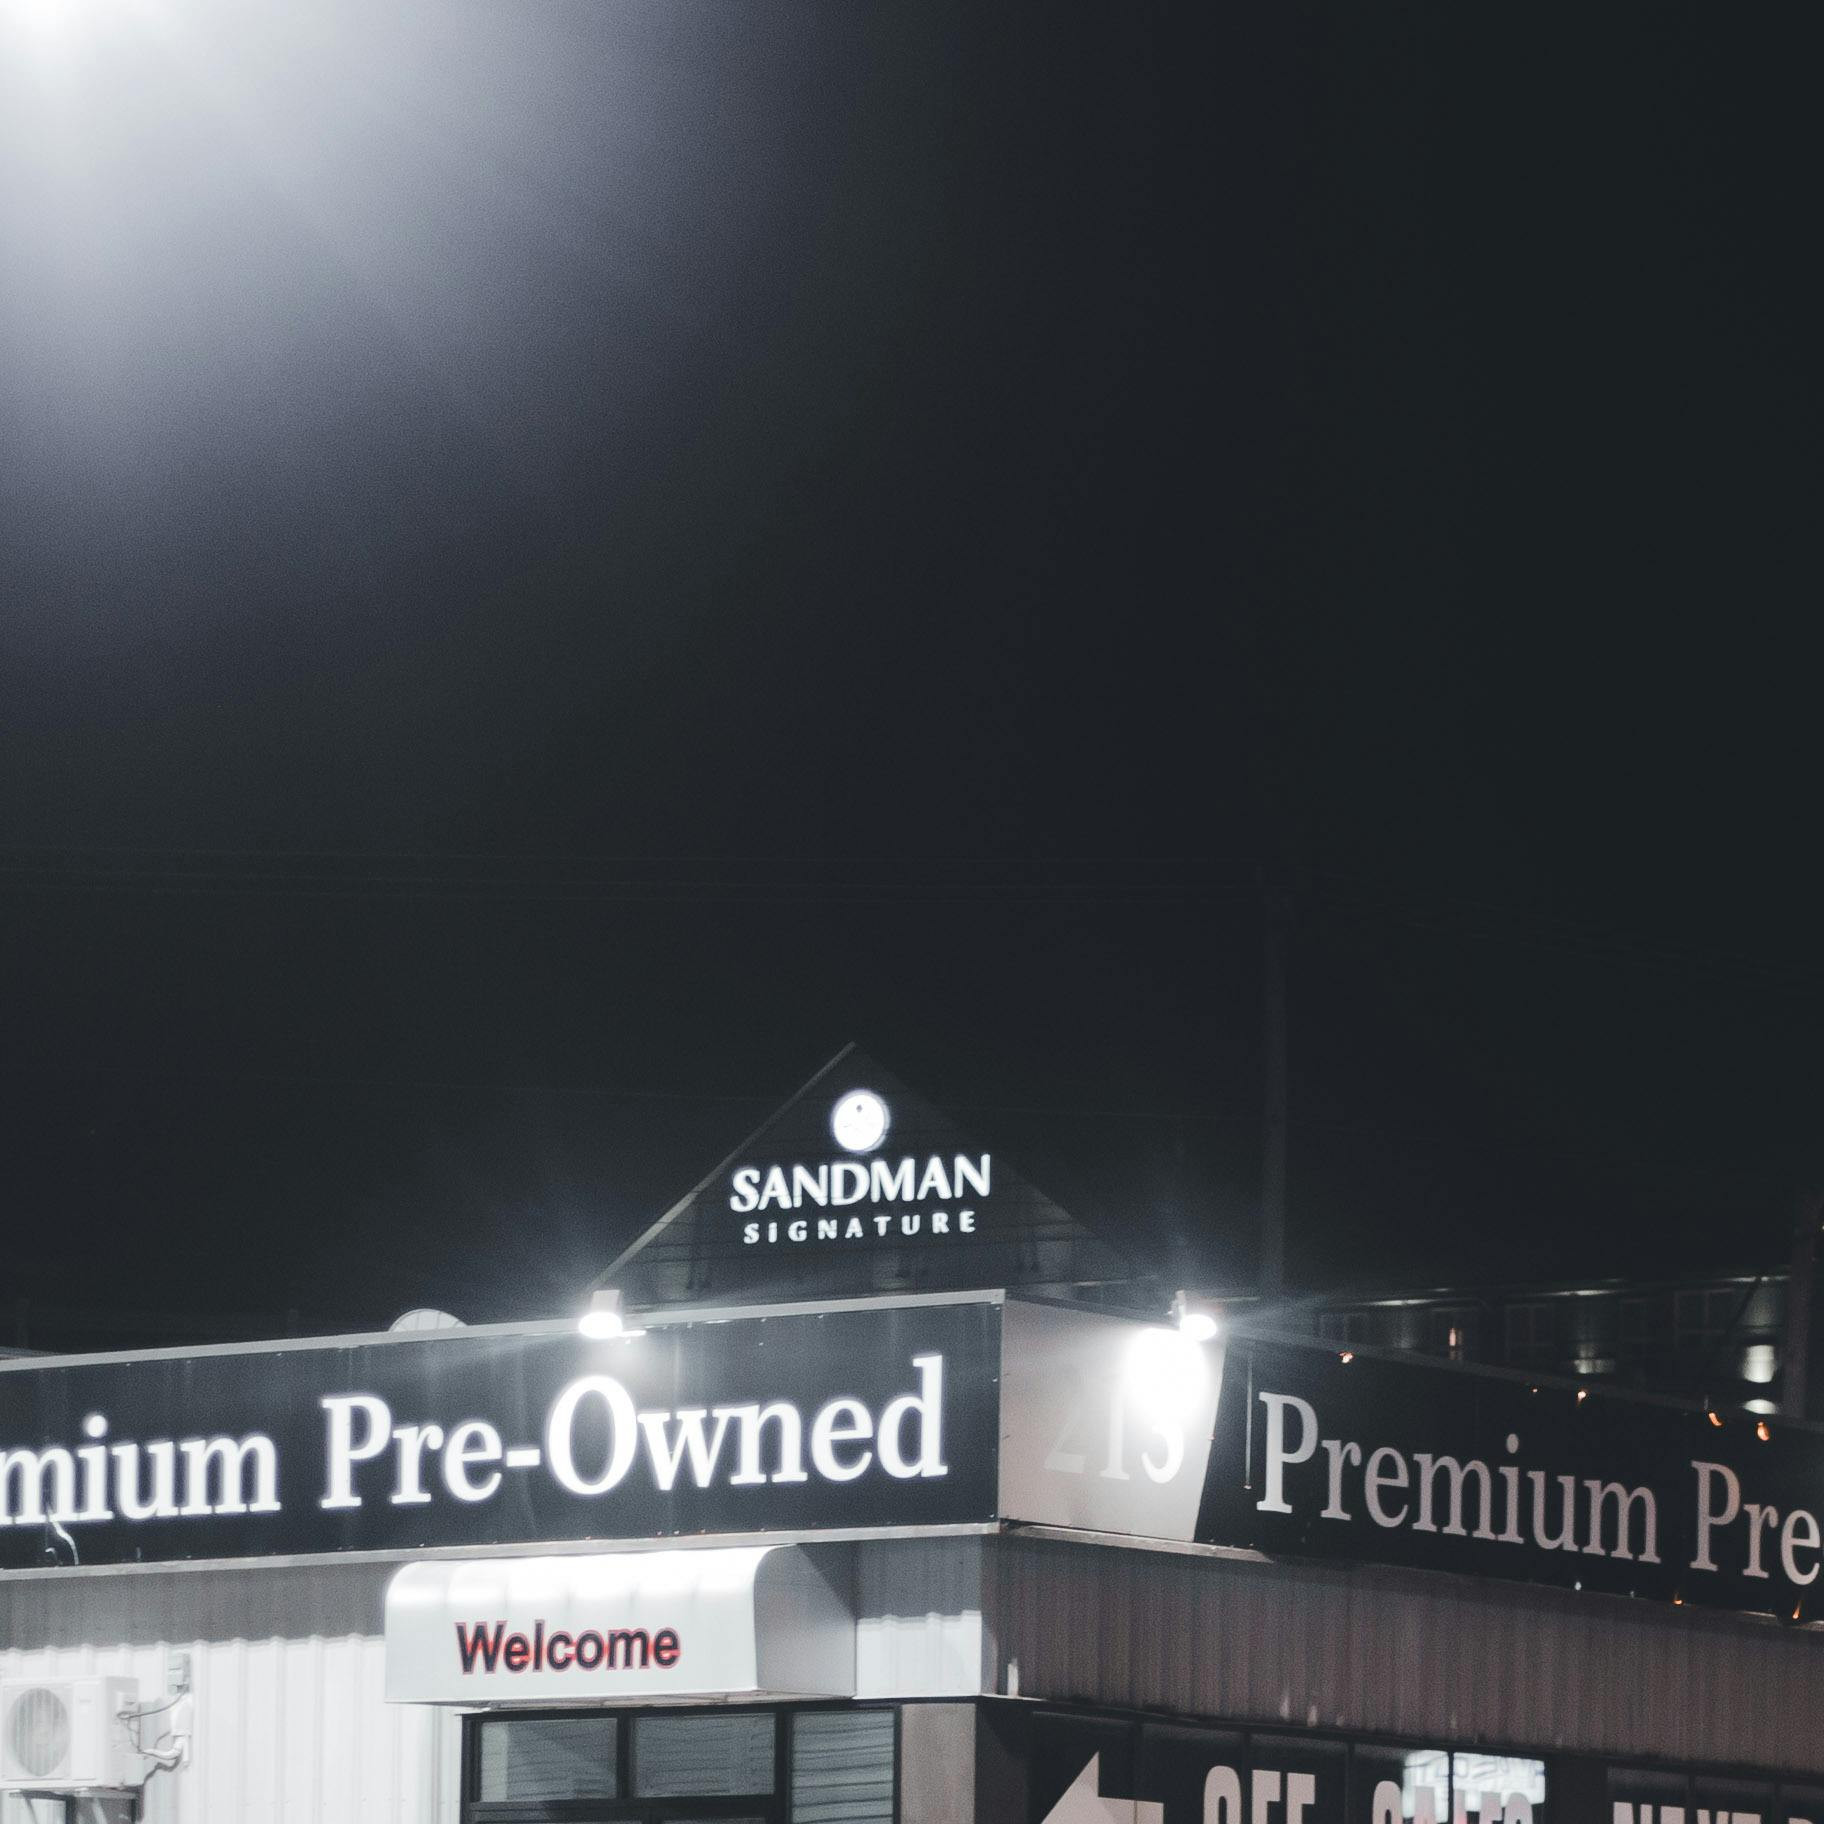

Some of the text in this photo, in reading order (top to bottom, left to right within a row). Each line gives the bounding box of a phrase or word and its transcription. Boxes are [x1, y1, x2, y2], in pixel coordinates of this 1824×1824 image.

[729, 1153, 991, 1212] SANDMAN
[743, 1210, 976, 1244] SIGNATURE
[320, 1354, 949, 1508] Pre-Owned
[1256, 1391, 1662, 1564] Premium
[454, 1618, 681, 1675] Welcome
